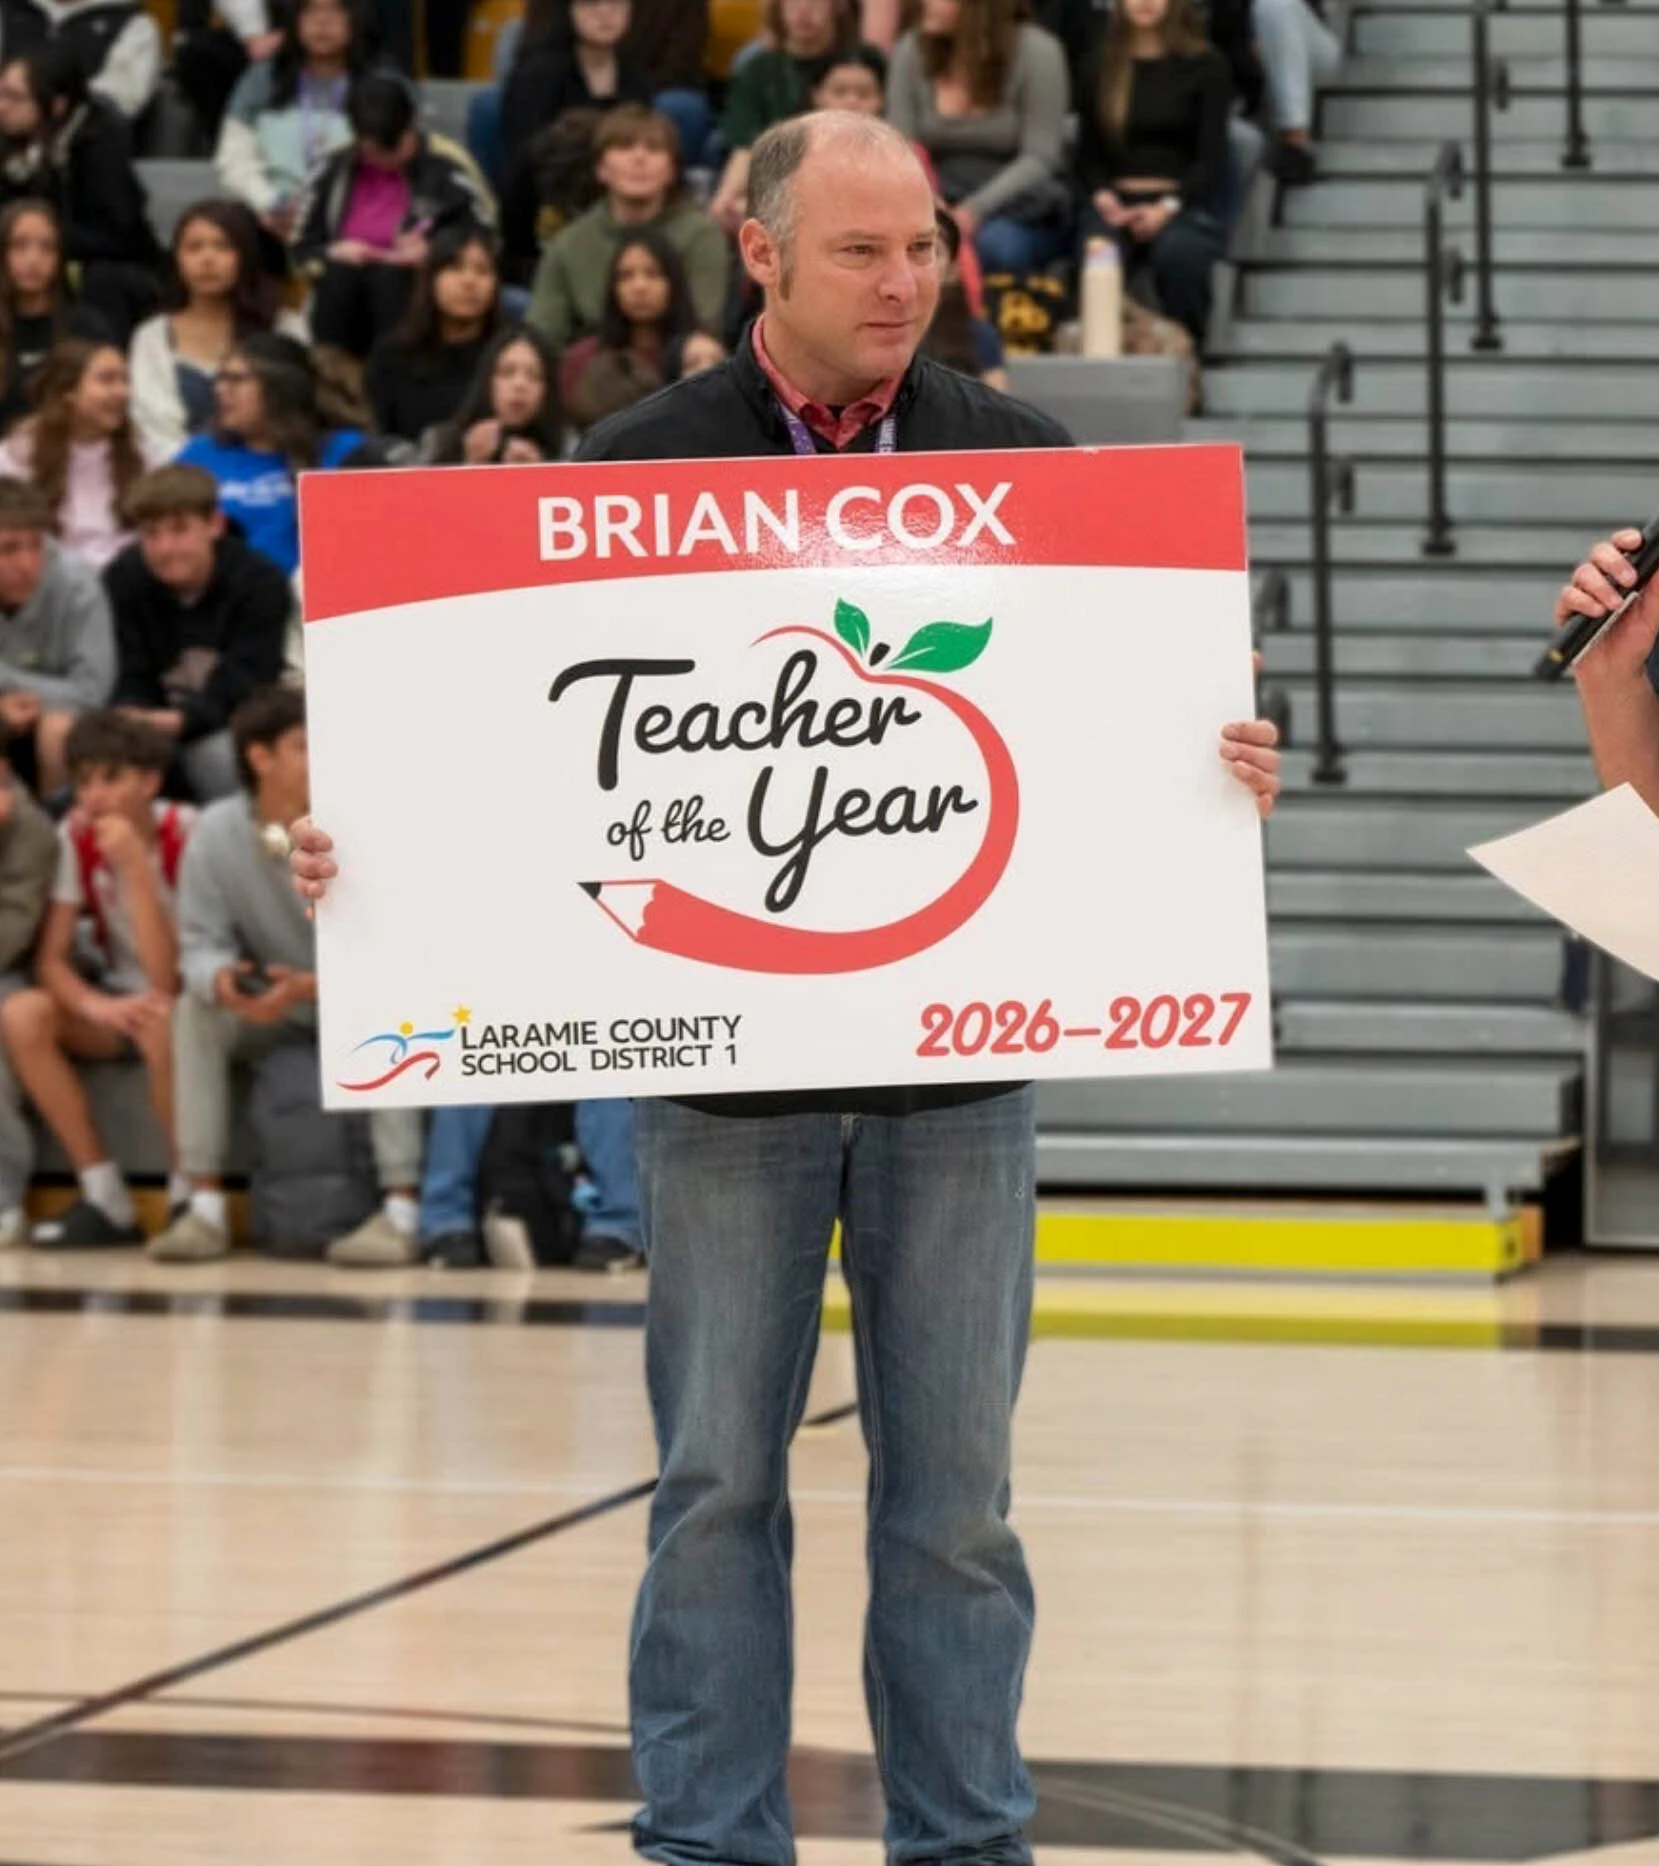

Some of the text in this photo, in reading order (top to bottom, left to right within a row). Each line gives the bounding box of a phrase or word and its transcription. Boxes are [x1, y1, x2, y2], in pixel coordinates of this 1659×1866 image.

[537, 482, 1015, 561] BRIAN COX
[547, 649, 922, 791] Teacher
[606, 765, 980, 914] of the Year
[460, 1014, 743, 1050] LARAMIE COUNTY
[460, 1044, 737, 1077] SCHOOL DISTRICT 1
